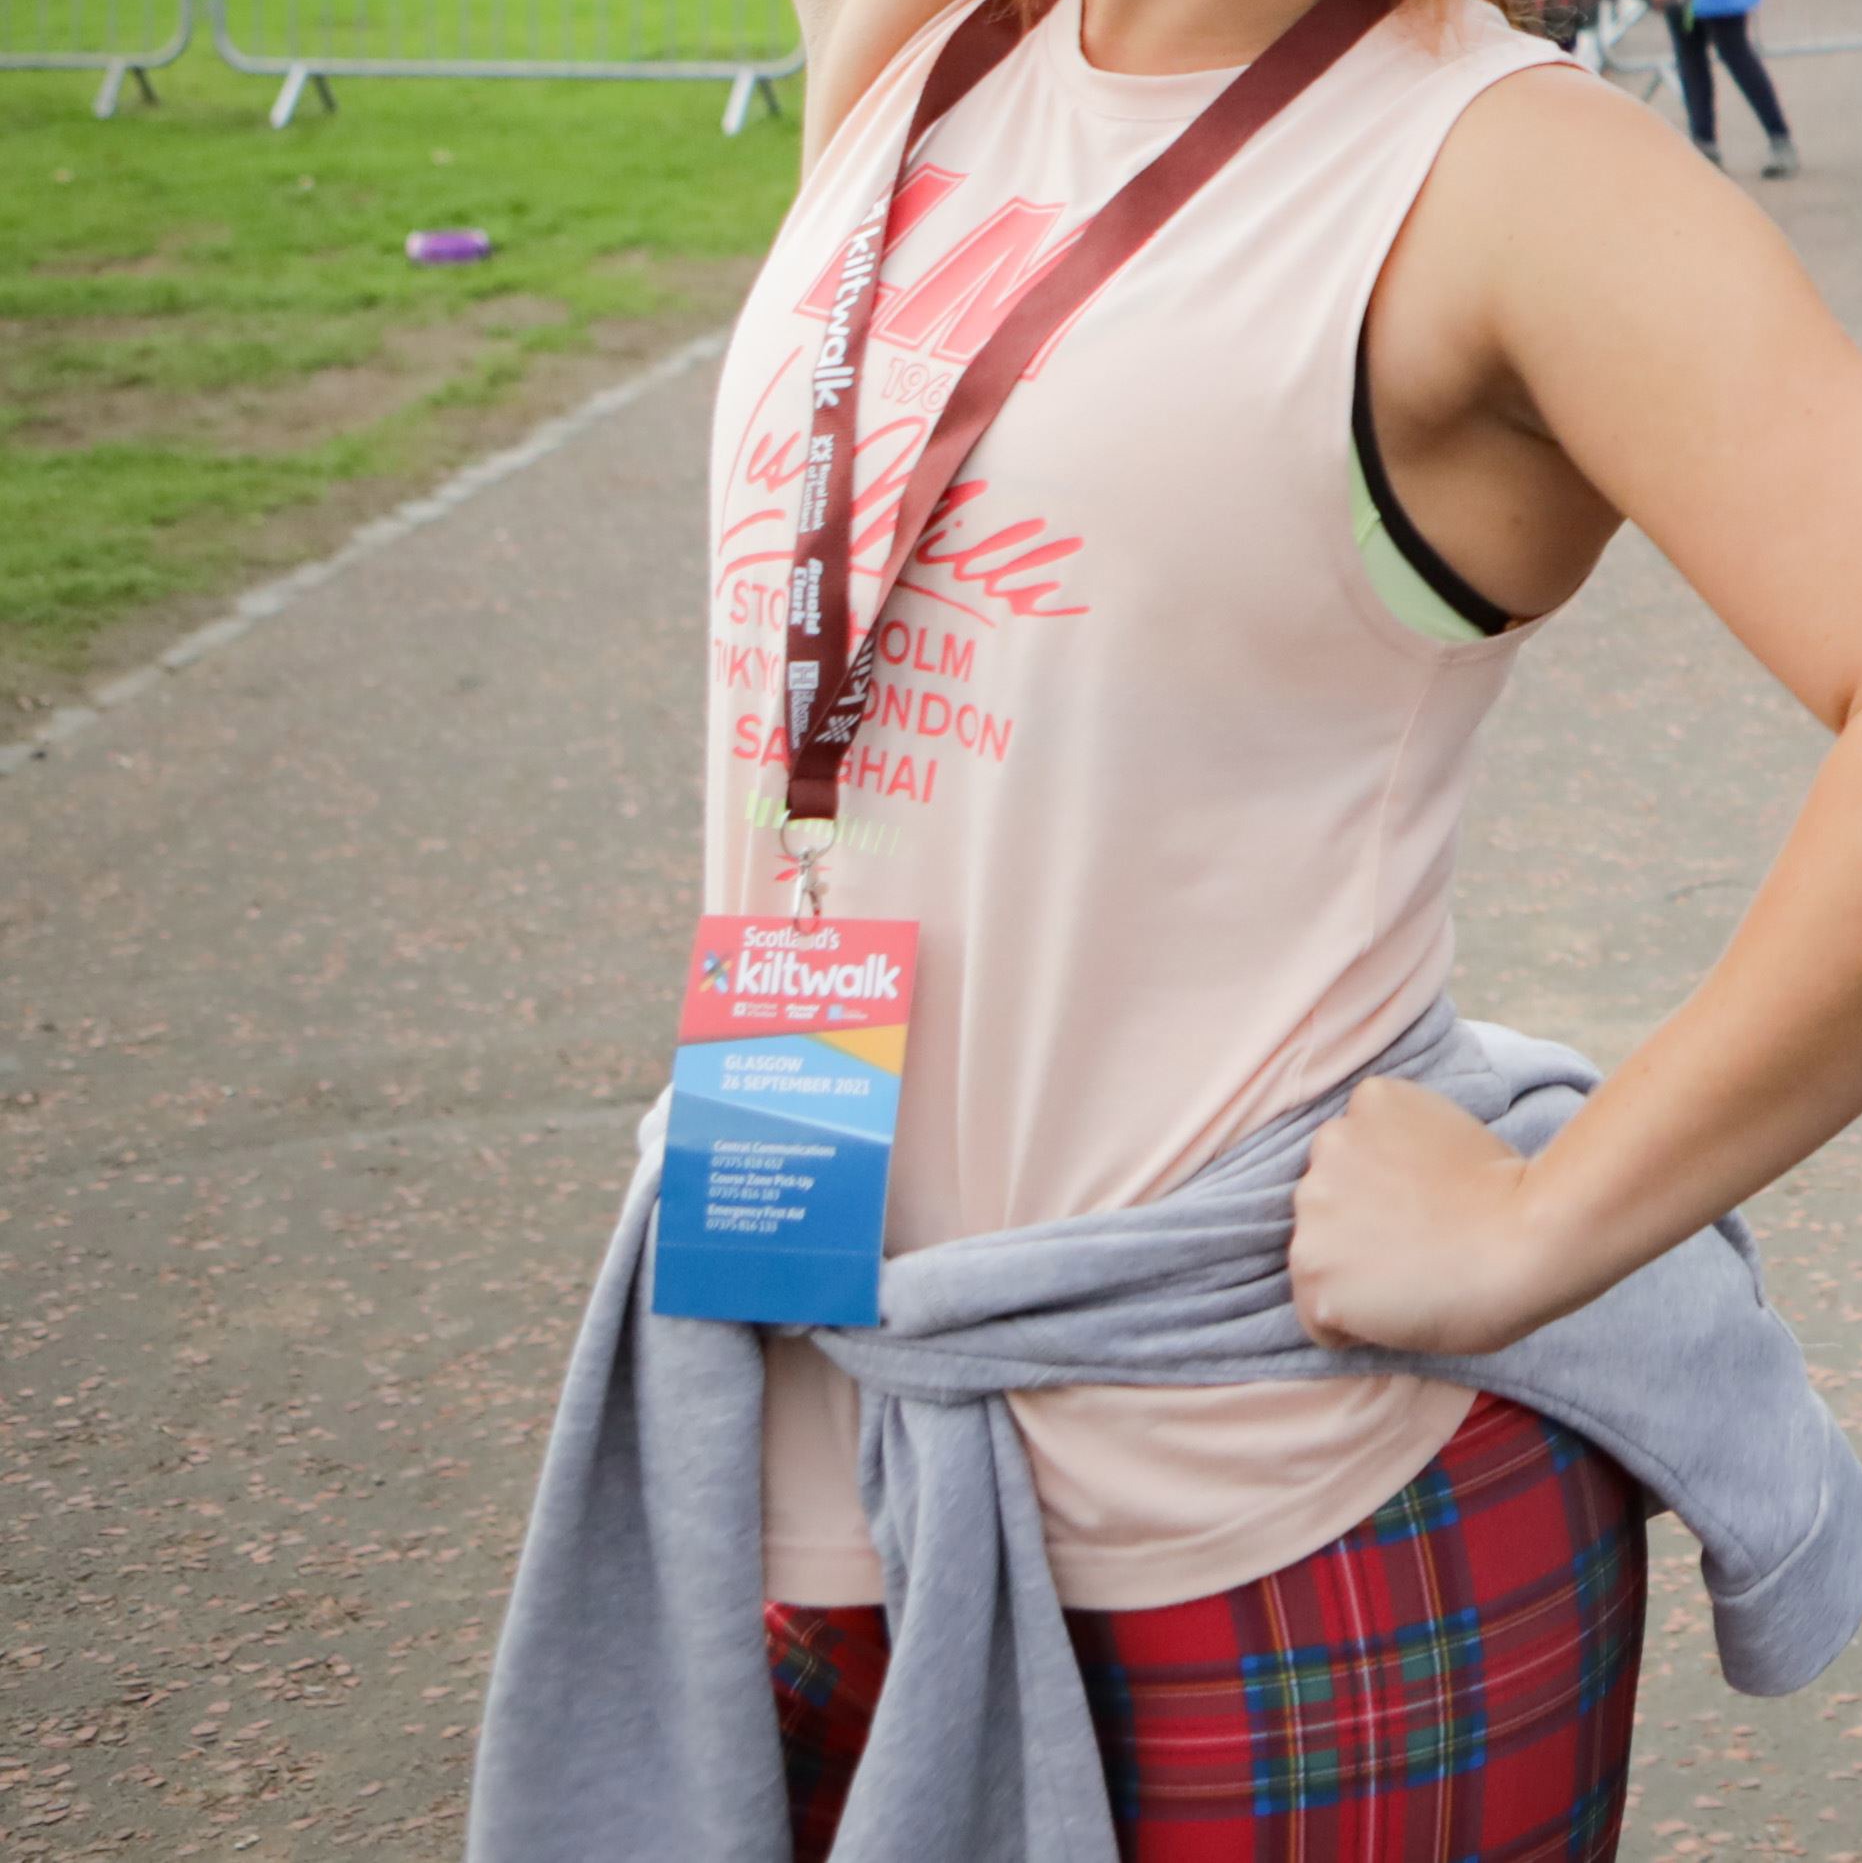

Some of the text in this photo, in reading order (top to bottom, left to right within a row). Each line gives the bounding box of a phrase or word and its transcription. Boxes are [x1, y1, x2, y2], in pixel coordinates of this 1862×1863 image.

[813, 226, 882, 410] kiltwalk
[883, 356, 952, 414] 196
[790, 566, 807, 626] Clark
[805, 558, 823, 635] Arnold
[861, 678, 1012, 762] ONDON
[735, 950, 900, 999] kiltwalk
[722, 1074, 740, 1090] 26
[743, 1075, 831, 1094] SEPTEMBER
[724, 1055, 804, 1072] GLASGOW
